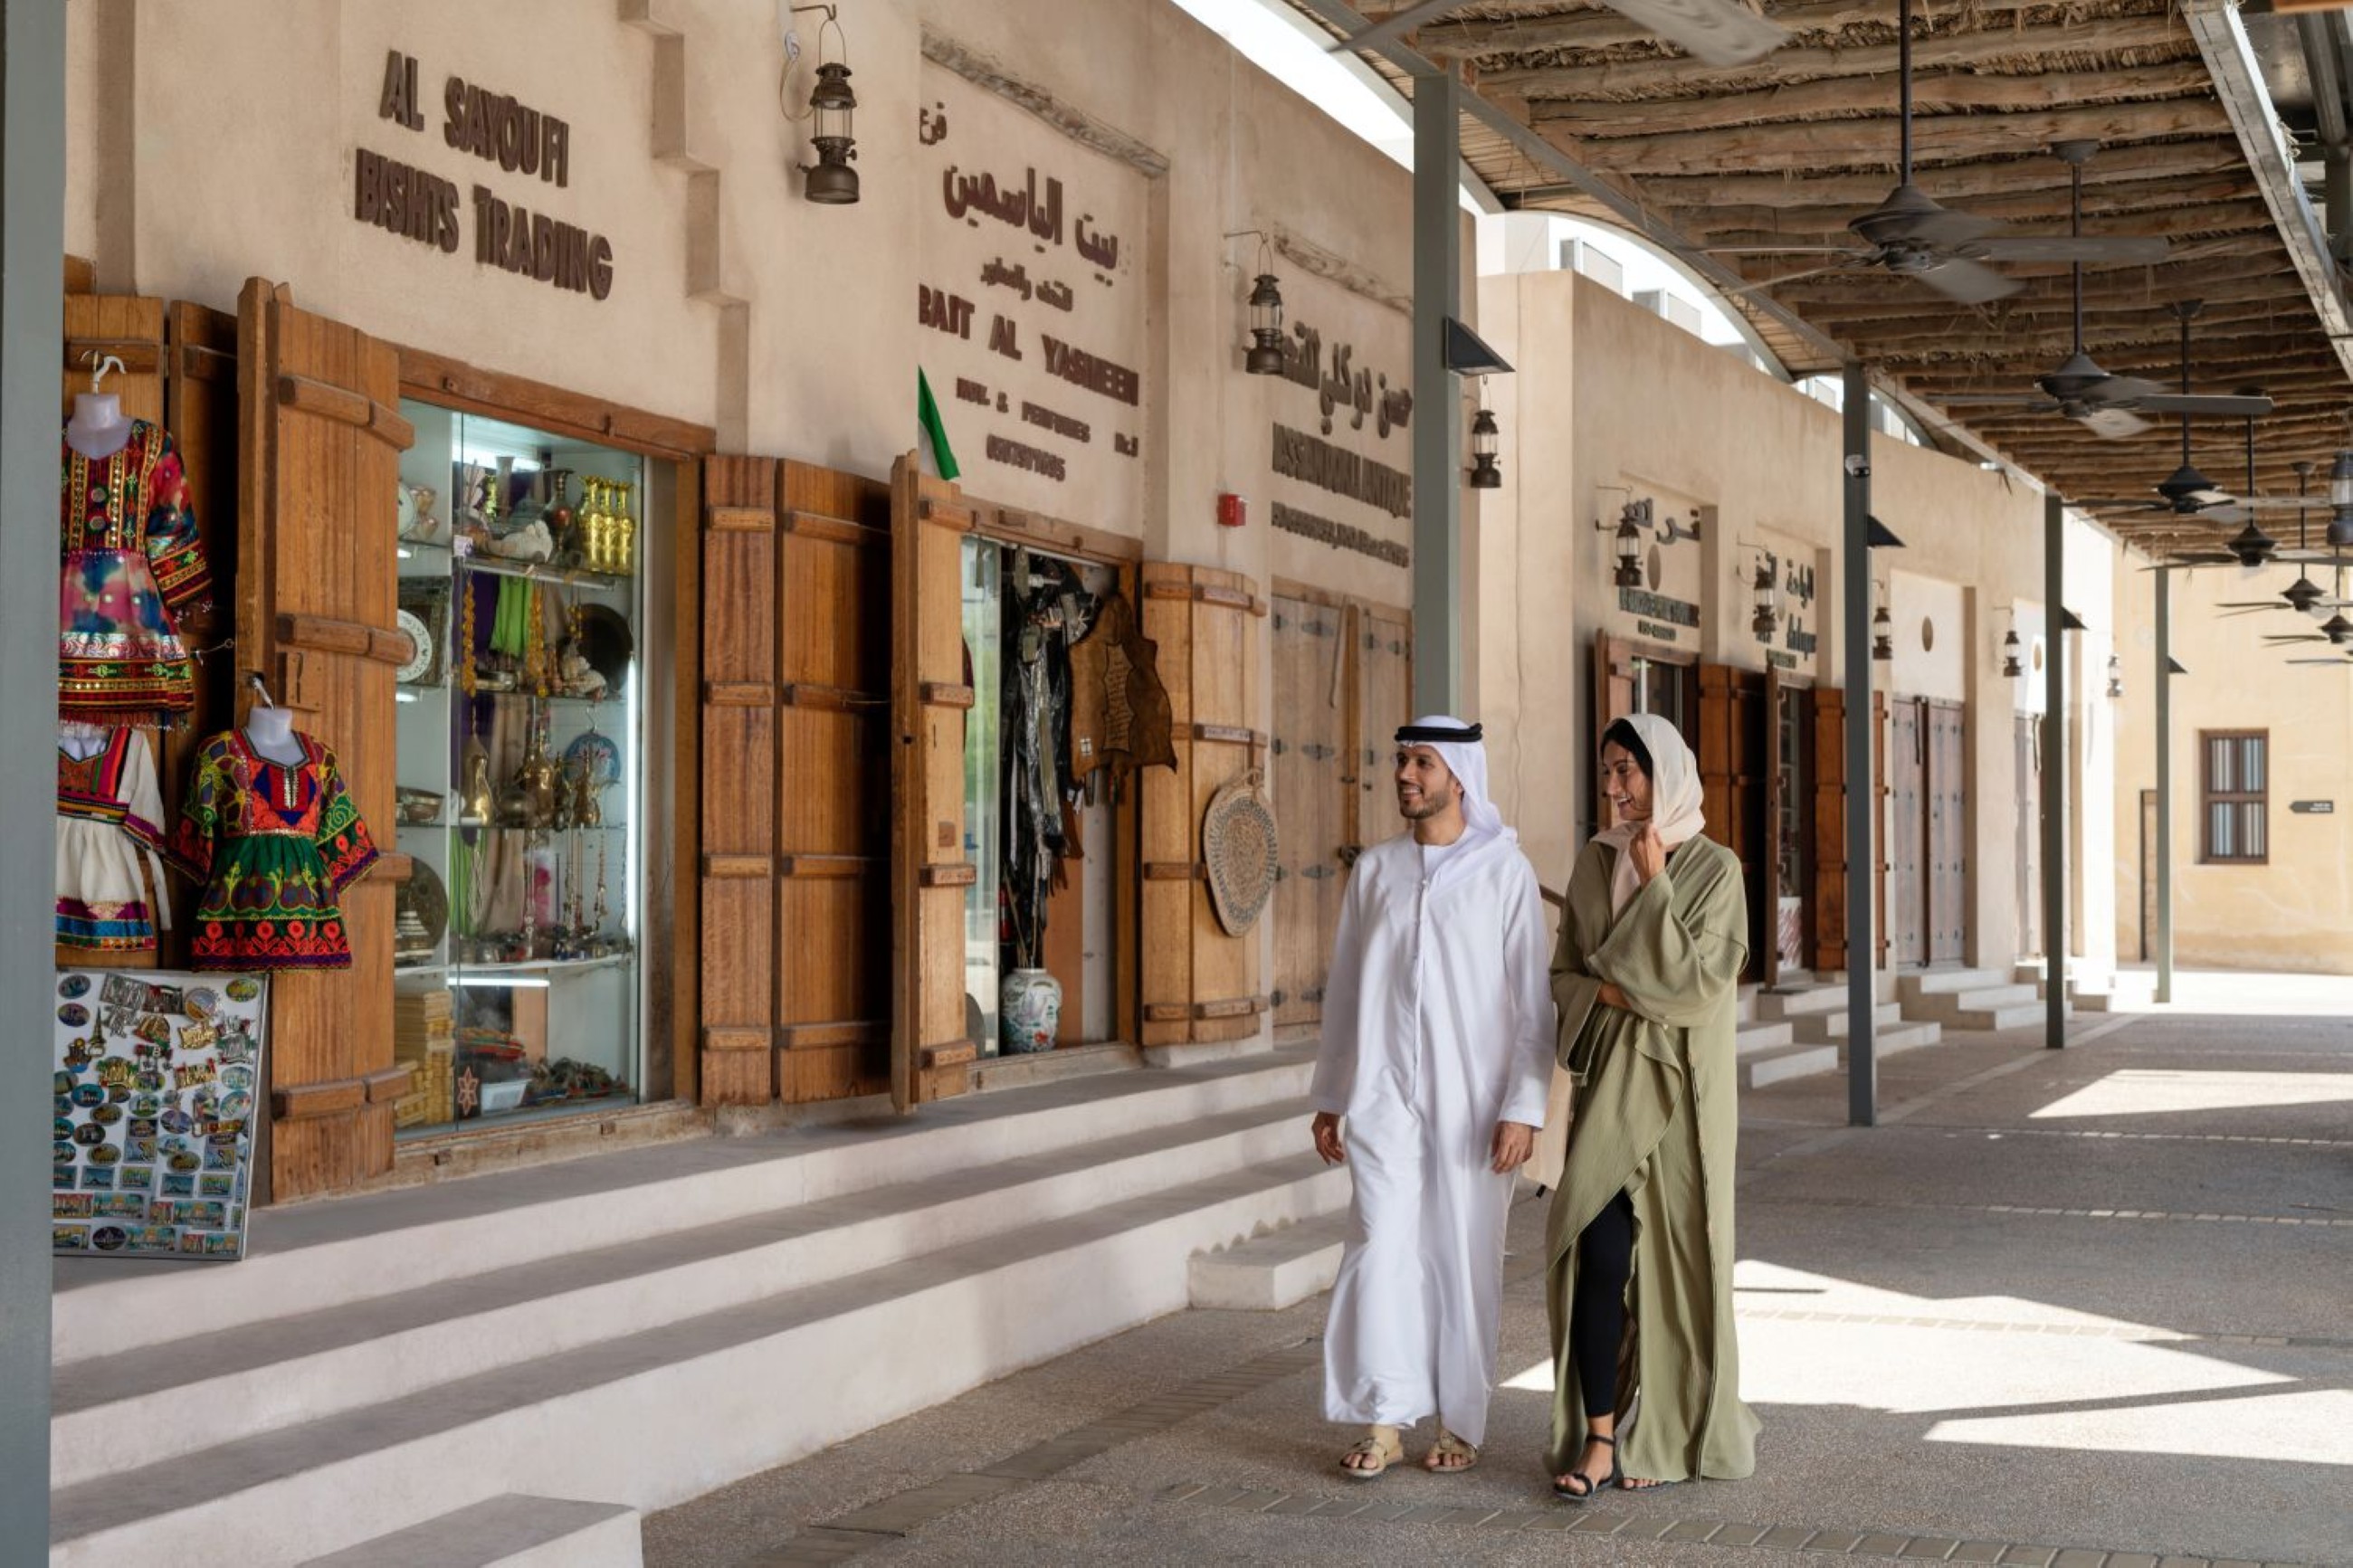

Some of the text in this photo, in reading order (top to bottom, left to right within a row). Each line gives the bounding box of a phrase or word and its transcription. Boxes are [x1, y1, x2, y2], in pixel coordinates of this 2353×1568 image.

[379, 50, 570, 188] AL SAYOUFI
[355, 148, 614, 301] BISHTS TRADING
[942, 165, 1118, 287] بيت الياسمين
[919, 282, 976, 340] BAIT
[987, 313, 1023, 361] AL
[1041, 333, 1139, 407] YASMEEN
